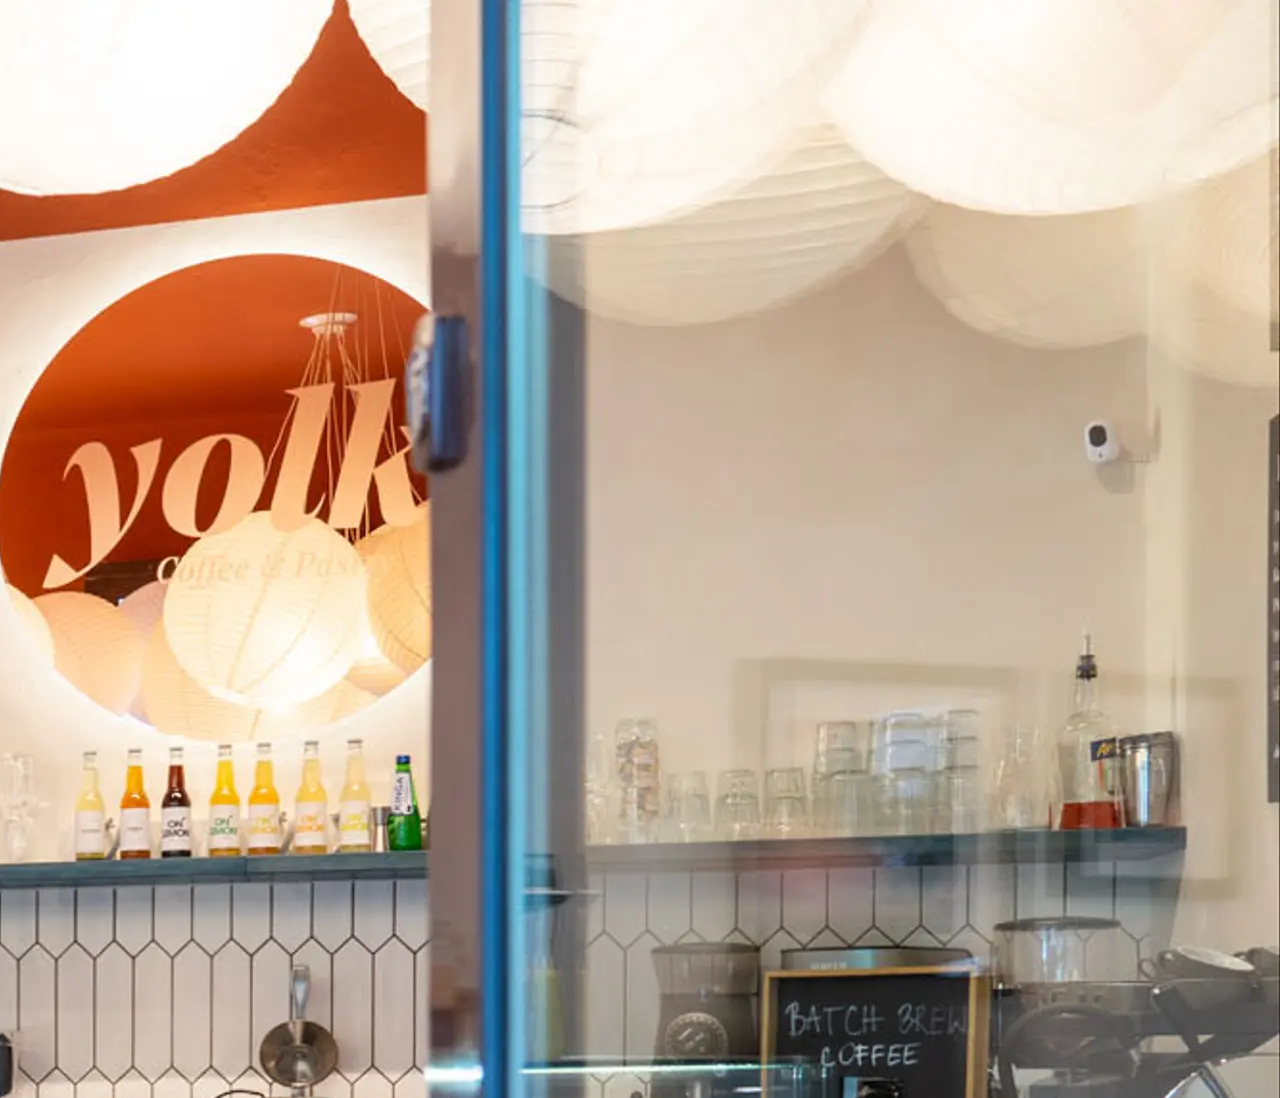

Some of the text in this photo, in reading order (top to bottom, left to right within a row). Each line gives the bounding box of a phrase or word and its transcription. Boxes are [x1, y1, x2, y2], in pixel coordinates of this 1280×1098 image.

[42, 378, 431, 590] yolk
[156, 555, 252, 591] Coffee
[161, 828, 190, 839] LEMON
[167, 820, 184, 830] ON
[785, 1002, 969, 1037] BATCH BREW
[820, 1042, 921, 1068] COFFEE
